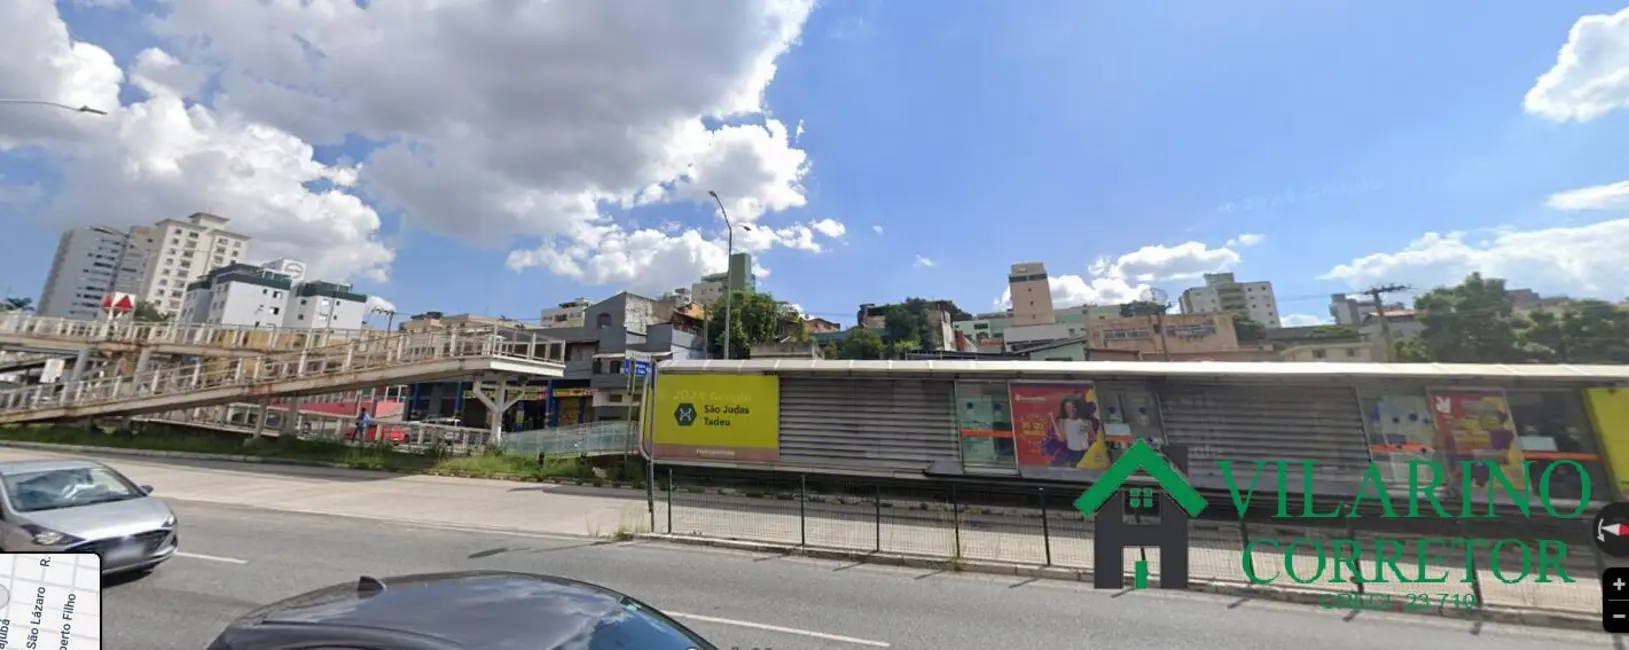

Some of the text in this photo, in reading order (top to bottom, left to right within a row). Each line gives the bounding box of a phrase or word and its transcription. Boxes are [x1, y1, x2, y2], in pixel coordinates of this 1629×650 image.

[704, 404, 750, 415] São Judas
[704, 417, 731, 426] Tadeu
